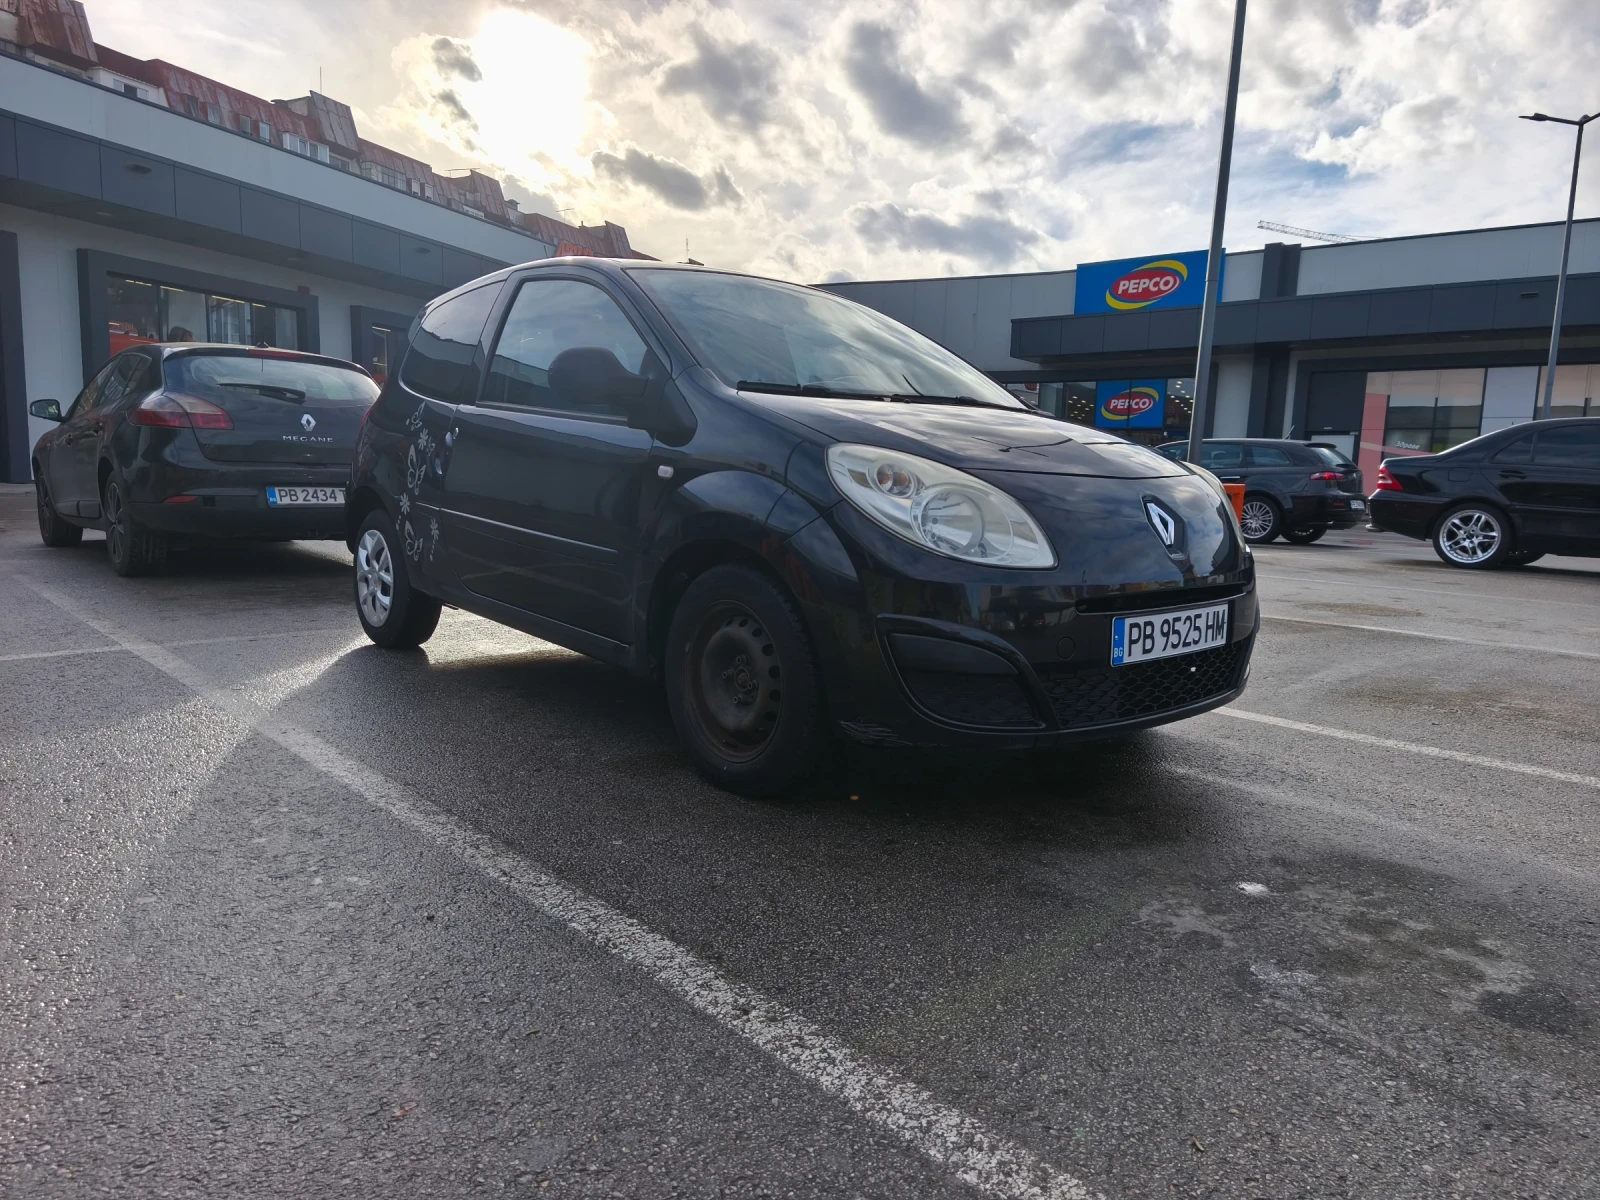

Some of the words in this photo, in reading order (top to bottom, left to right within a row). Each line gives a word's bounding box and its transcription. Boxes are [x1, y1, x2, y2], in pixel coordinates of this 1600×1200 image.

[1117, 275, 1175, 295] PEPCO
[1109, 397, 1150, 409] PEPCO
[282, 435, 334, 443] MEGANE
[278, 488, 299, 502] PB
[301, 488, 337, 502] 2434
[1127, 620, 1155, 657] PB
[1160, 613, 1203, 652] 9525
[1204, 609, 1227, 643] HM
[1113, 646, 1124, 658] BG
